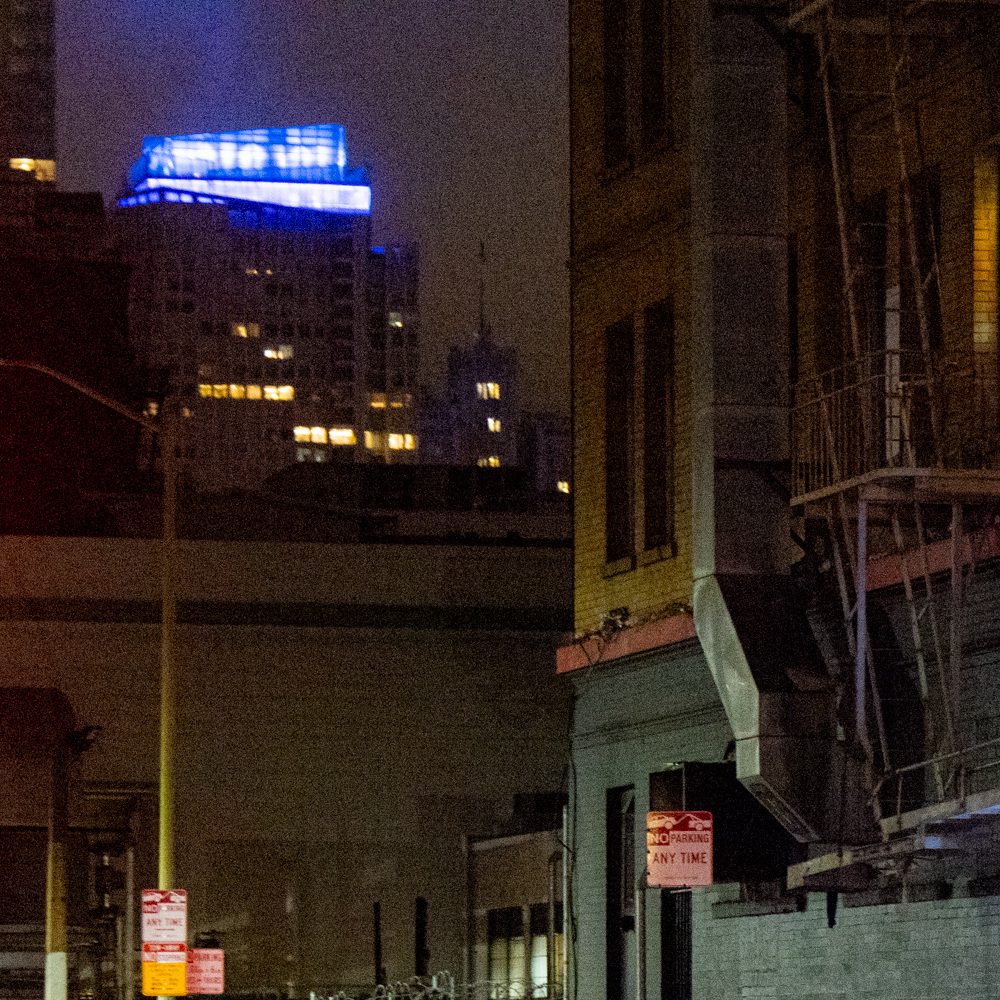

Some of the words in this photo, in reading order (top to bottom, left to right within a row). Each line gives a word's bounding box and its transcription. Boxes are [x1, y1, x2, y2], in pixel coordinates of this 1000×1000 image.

[652, 833, 669, 843] NO
[670, 833, 710, 843] PARKING
[653, 852, 676, 864] ANY
[680, 852, 707, 864] TIME
